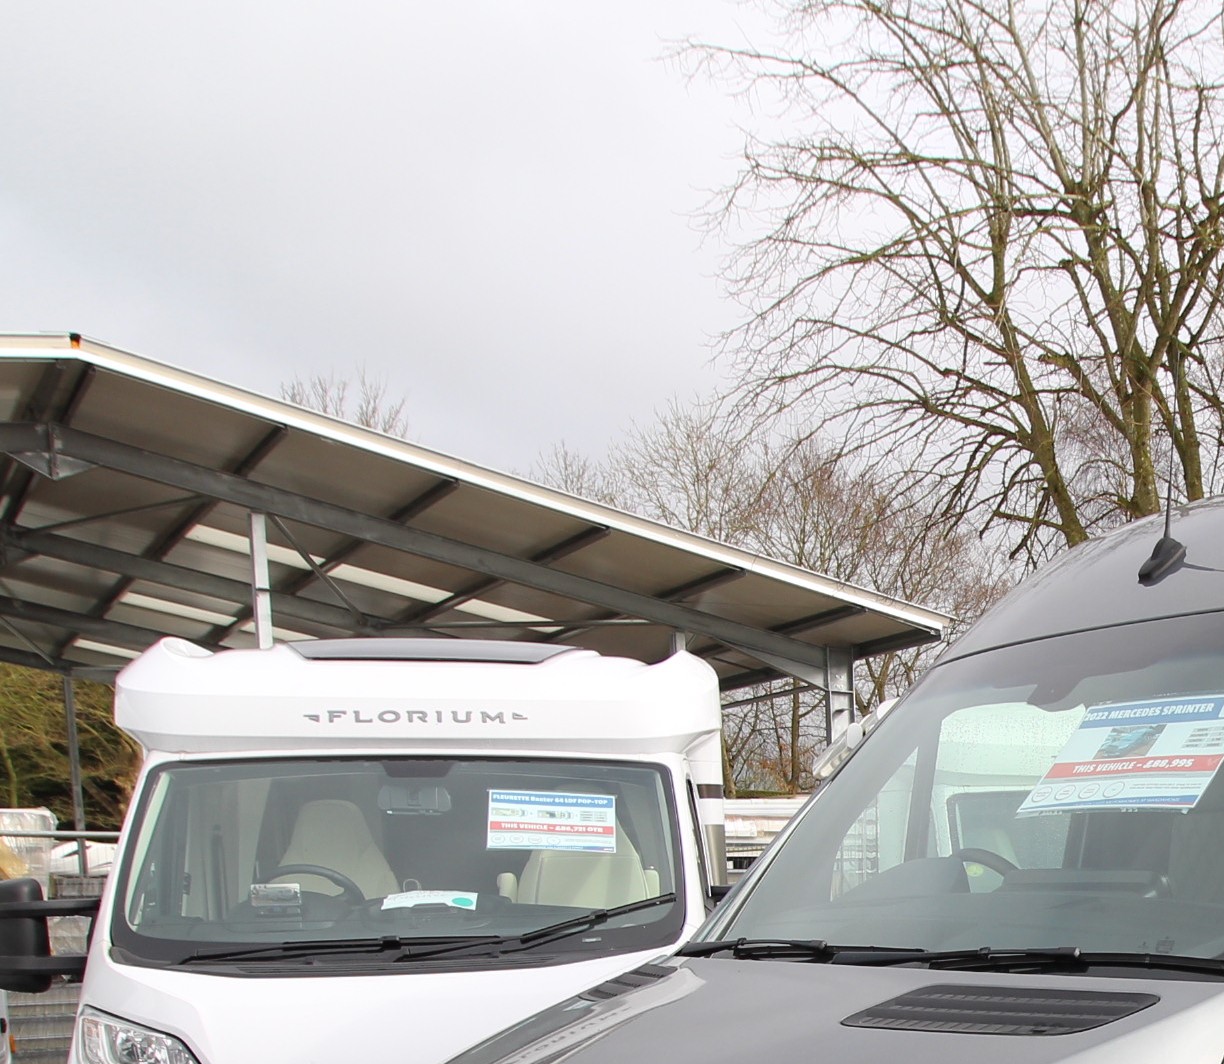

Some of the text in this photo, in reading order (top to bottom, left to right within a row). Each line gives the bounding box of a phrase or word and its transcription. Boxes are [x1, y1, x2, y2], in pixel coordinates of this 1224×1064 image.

[327, 710, 506, 724] FLORIUM
[1108, 706, 1161, 719] MERCEDES
[1162, 703, 1215, 715] SPRINTER
[1072, 764, 1095, 774] THIS
[1096, 761, 1137, 772] VEHICLE
